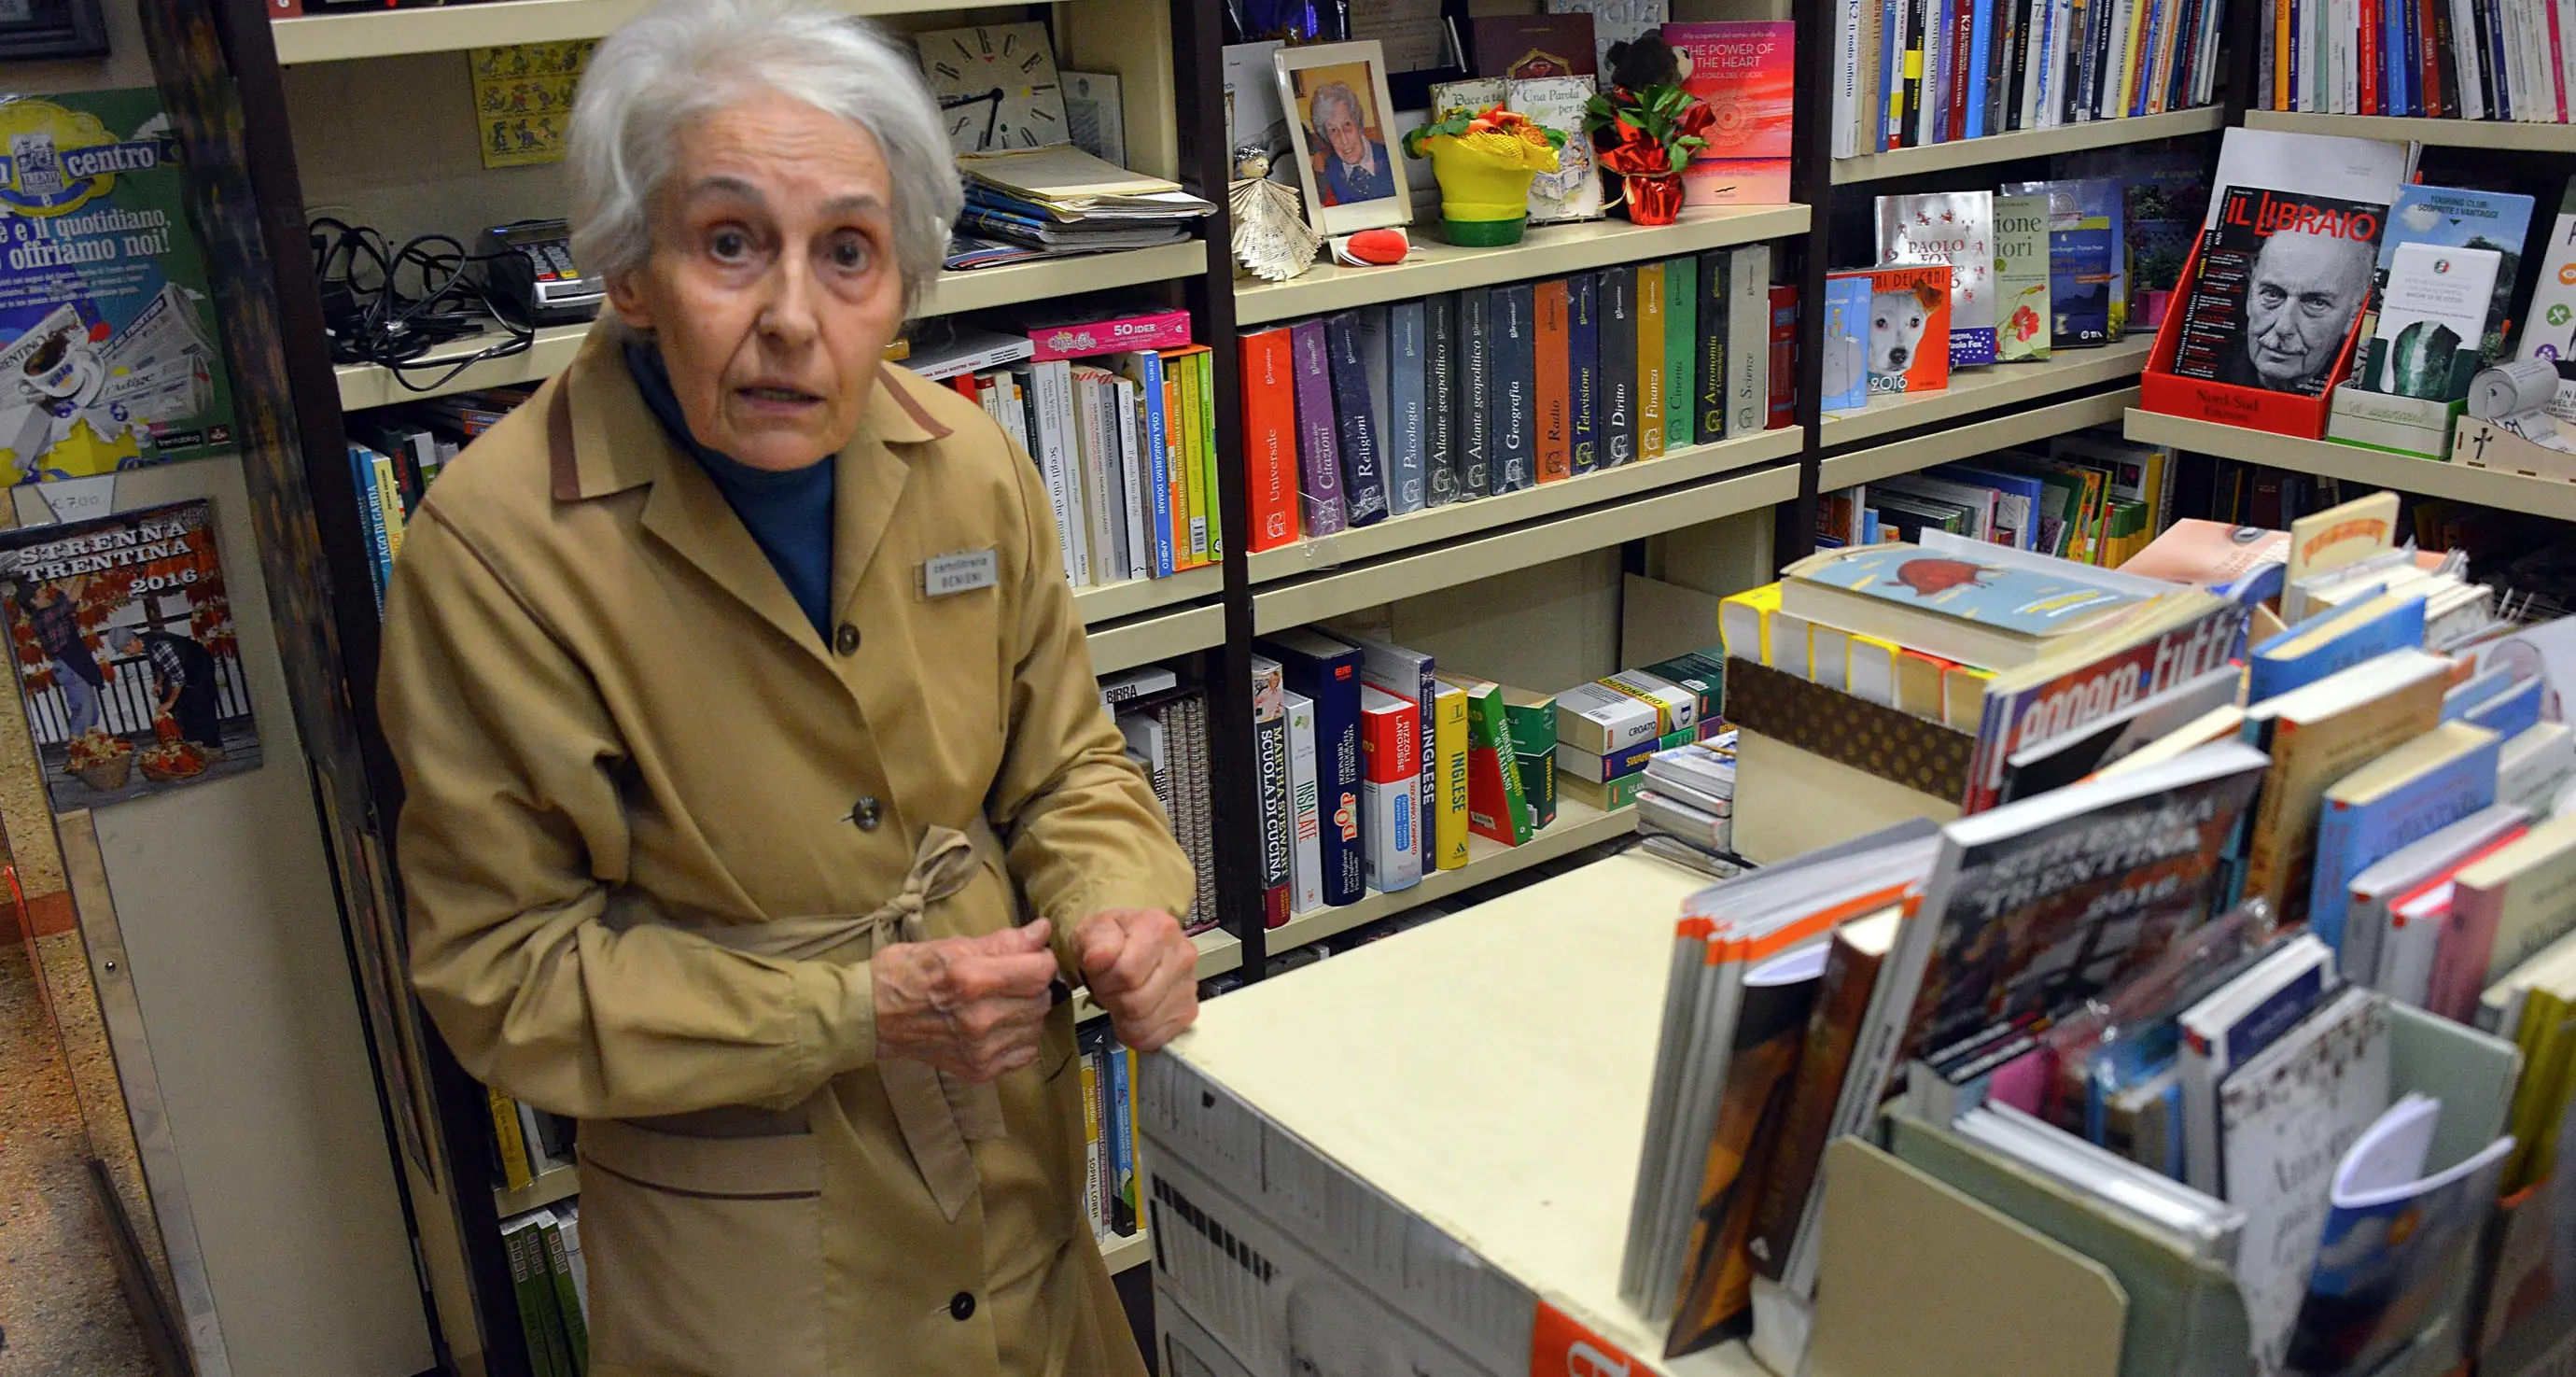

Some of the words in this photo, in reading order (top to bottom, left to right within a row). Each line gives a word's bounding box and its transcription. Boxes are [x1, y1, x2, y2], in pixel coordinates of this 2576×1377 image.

[1961, 15, 1971, 32] K2
[1684, 45, 1706, 55] THE
[1709, 44, 1754, 54] POWER
[1757, 43, 1774, 53] OF
[1697, 57, 1718, 68] THE
[1722, 56, 1761, 67] HEART
[1549, 89, 1580, 102] Parola
[1846, 63, 1855, 97] infinito
[1559, 105, 1574, 115] per
[68, 146, 153, 176] centro
[2226, 196, 2252, 226] IL
[2254, 190, 2378, 242] LIBRAIO
[2430, 195, 2465, 207] TOURING
[2460, 208, 2499, 219] VANTAGGI
[14, 222, 28, 242] e
[34, 217, 50, 239] il
[55, 209, 172, 242] quotidiano,
[1909, 239, 1965, 254] PAOLO
[9, 239, 116, 271] offriamo
[124, 229, 171, 257] noi!
[1994, 237, 2033, 258] iori
[1113, 324, 1134, 335] 50
[1134, 324, 1155, 333] IDEE
[0, 336, 47, 372] RENTINO
[1469, 340, 1482, 409] geopolitico
[1704, 335, 1717, 404] Astronomia
[1434, 344, 1447, 413] geopolitico
[1645, 369, 1659, 418] Finanza
[1671, 360, 1683, 410] Cinema
[1740, 352, 1754, 399] Scienze
[1870, 377, 1908, 391] 2016
[1505, 380, 1520, 450] Geografia
[1547, 400, 1561, 442] Radio
[1576, 367, 1590, 434] Televisione
[1612, 384, 1625, 427] Diritto
[1152, 412, 1161, 432] COSA
[1403, 401, 1418, 469] Psicologia
[1433, 416, 1448, 464] Atlante
[1467, 412, 1483, 459] Atlante
[1050, 447, 1060, 478] Scegli
[1153, 434, 1163, 482] MANGEREMO
[1268, 429, 1281, 502] Universale
[1319, 428, 1334, 489] Citazioni
[1354, 415, 1374, 476] Religioni
[368, 485, 382, 522] GARDA
[1155, 484, 1166, 514] DOMANI
[20, 520, 190, 566] STRENNA
[22, 538, 193, 583] TRENTINA
[377, 534, 390, 564] LAGO
[129, 568, 200, 597] 2016
[1106, 684, 1138, 704] BIRRA
[1603, 679, 1663, 705] DIZIONARIO
[1395, 715, 1405, 772] LAROUSSE
[1499, 719, 1514, 762] DIZIONARIO
[1628, 721, 1657, 737] CROATO
[1261, 730, 1278, 798] SCUOLA
[1273, 724, 1284, 800] MARTHA
[1451, 752, 1465, 813] INGLESE
[1495, 745, 1512, 791] ITALIANO
[1153, 768, 1168, 802] BIRRA
[1628, 783, 1645, 794] OLAN
[1266, 799, 1277, 816] DI
[1295, 780, 1317, 844] INSALATE
[1334, 793, 1357, 842] DOP
[1267, 819, 1281, 882] CUCINA
[1278, 802, 1288, 877] STEWART
[1088, 1158, 1097, 1188] SOPHIA
[1090, 1191, 1099, 1218] LOREN
